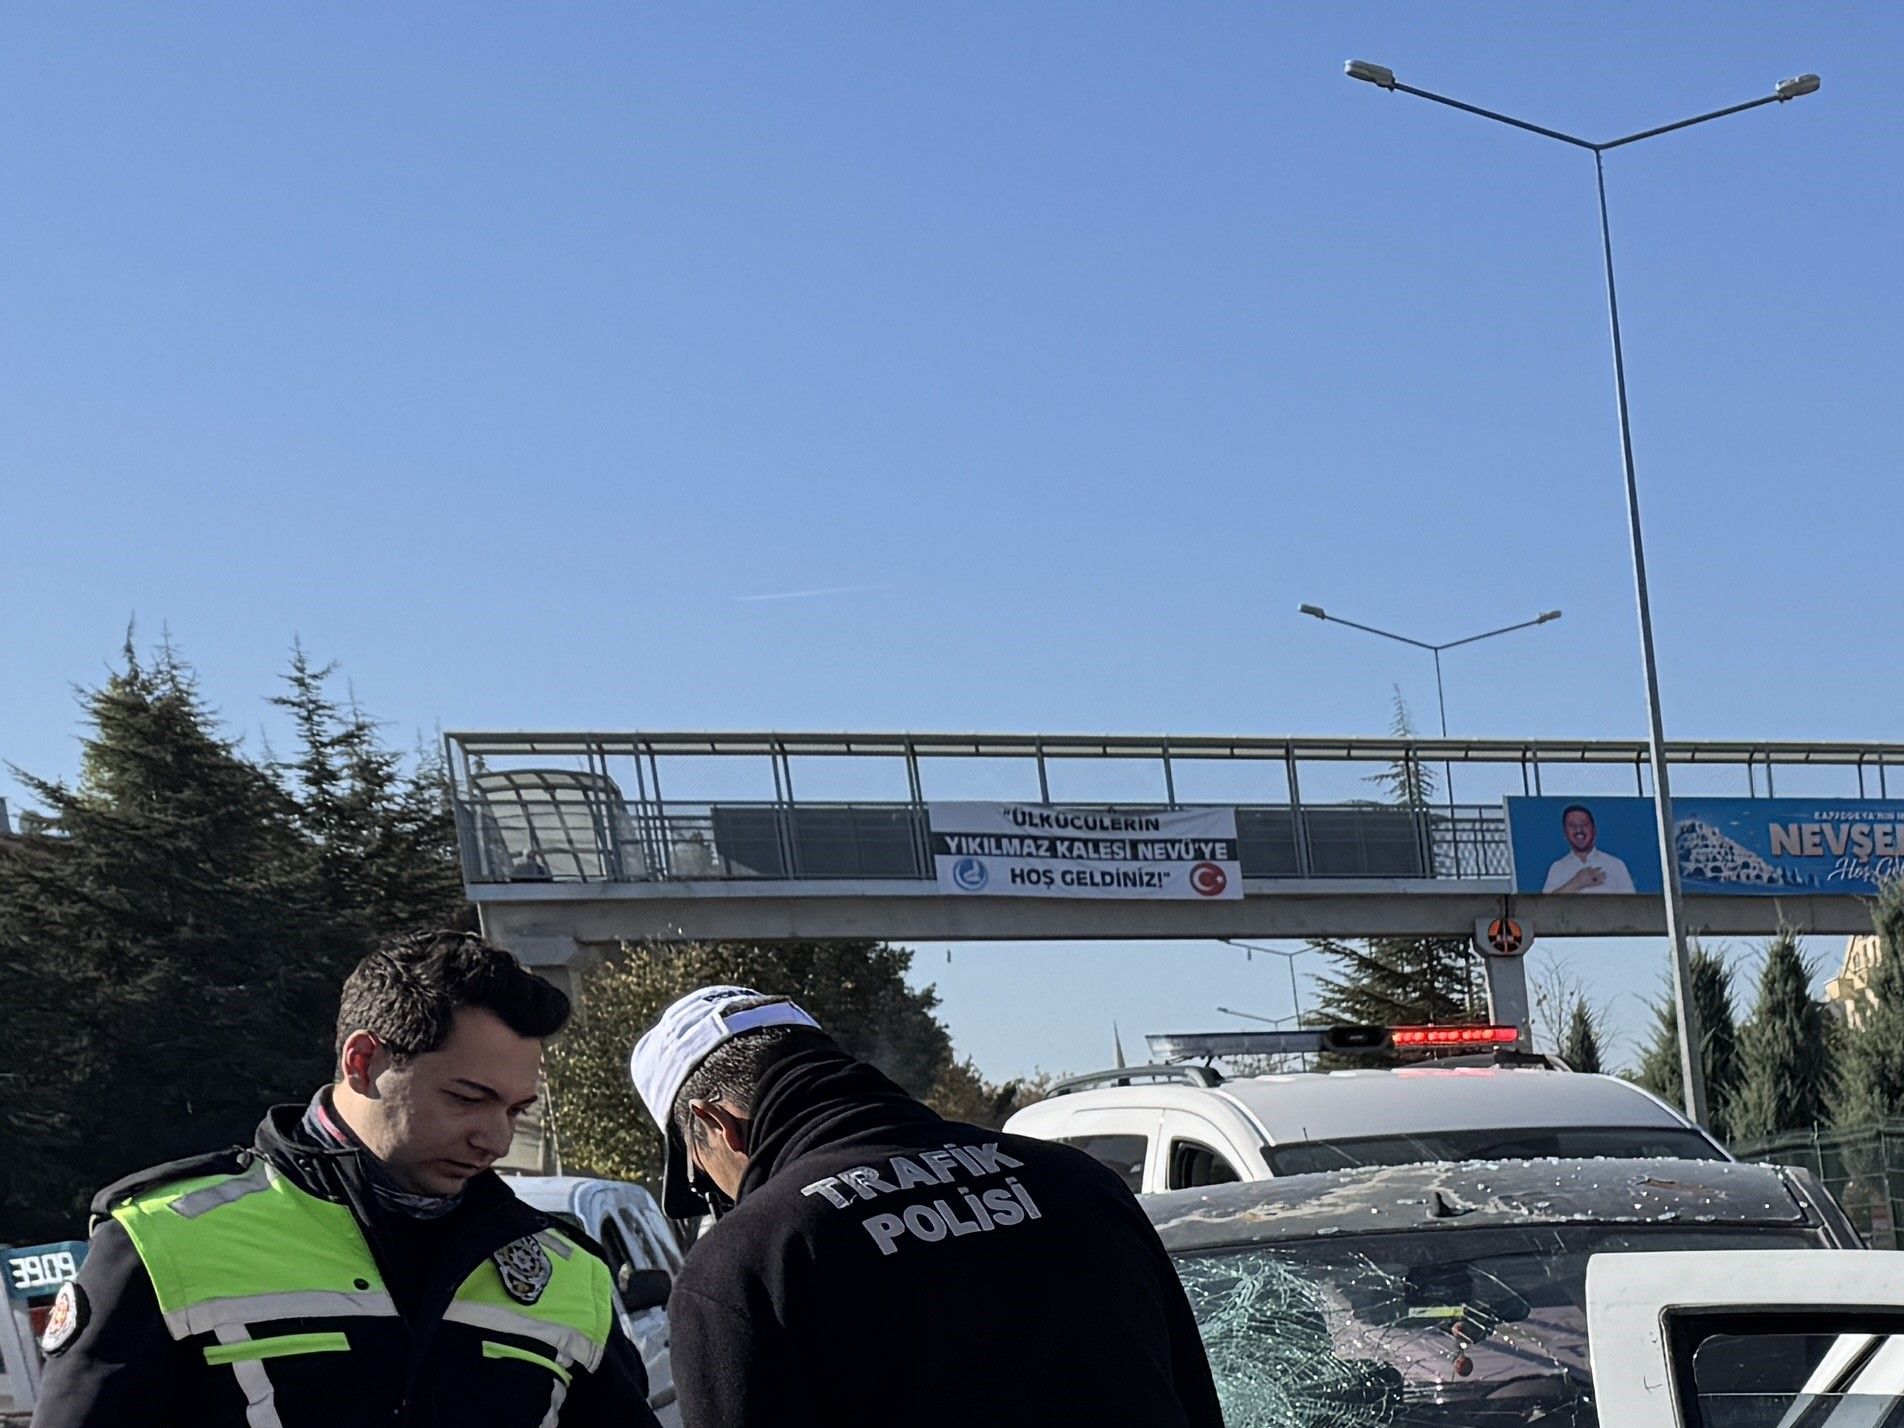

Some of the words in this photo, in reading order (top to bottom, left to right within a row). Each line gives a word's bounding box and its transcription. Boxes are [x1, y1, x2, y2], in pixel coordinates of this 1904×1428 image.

[945, 836, 1050, 857] YIKILMAZ
[1056, 838, 1131, 860] KALESİ
[1138, 838, 1228, 860] NEVÜ'YE
[1010, 867, 1055, 889] HOŞ
[800, 1142, 1025, 1210] TRAFİK
[861, 1176, 1043, 1256] POLİSİ
